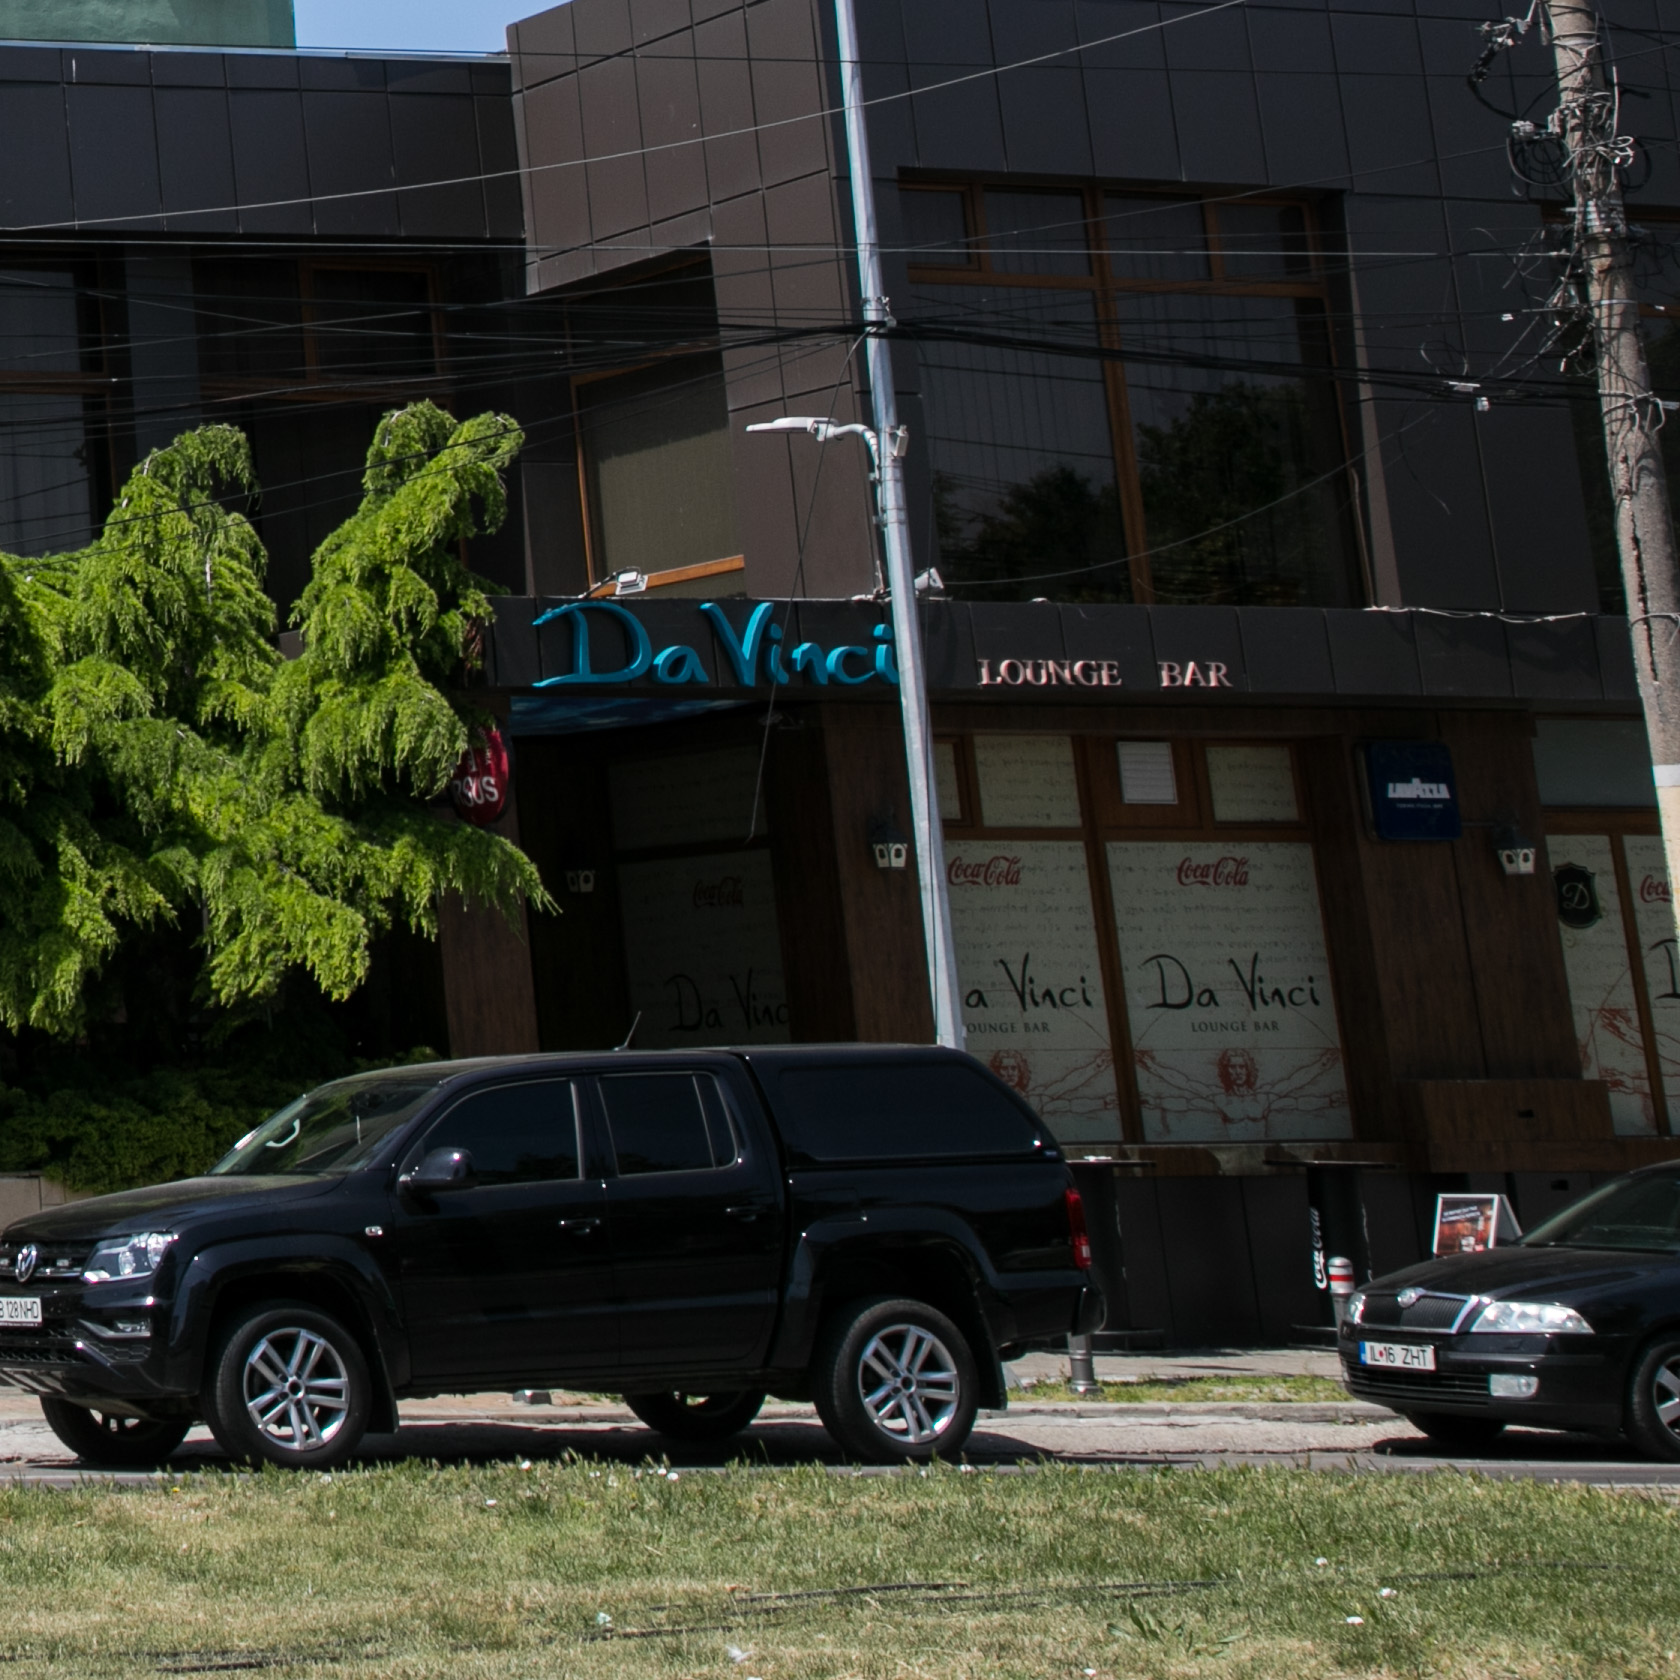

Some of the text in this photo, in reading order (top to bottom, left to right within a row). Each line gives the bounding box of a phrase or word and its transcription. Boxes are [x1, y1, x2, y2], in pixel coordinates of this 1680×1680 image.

[531, 601, 899, 687] Da Vinci
[977, 659, 1233, 688] LOUNGE BAR
[947, 856, 1022, 886] Coca-Cola
[1177, 857, 1249, 887] Coca-Cola
[998, 952, 1093, 1012] Vinci
[1142, 951, 1321, 1011] Da Vinci
[665, 967, 789, 1031] Da Vinc
[966, 1021, 1051, 1034] OUNGE BAR
[1191, 1020, 1280, 1033] LOUNGE BAR
[6, 1300, 19, 1318] 128
[1370, 1345, 1427, 1366] IL 16 ZHT
